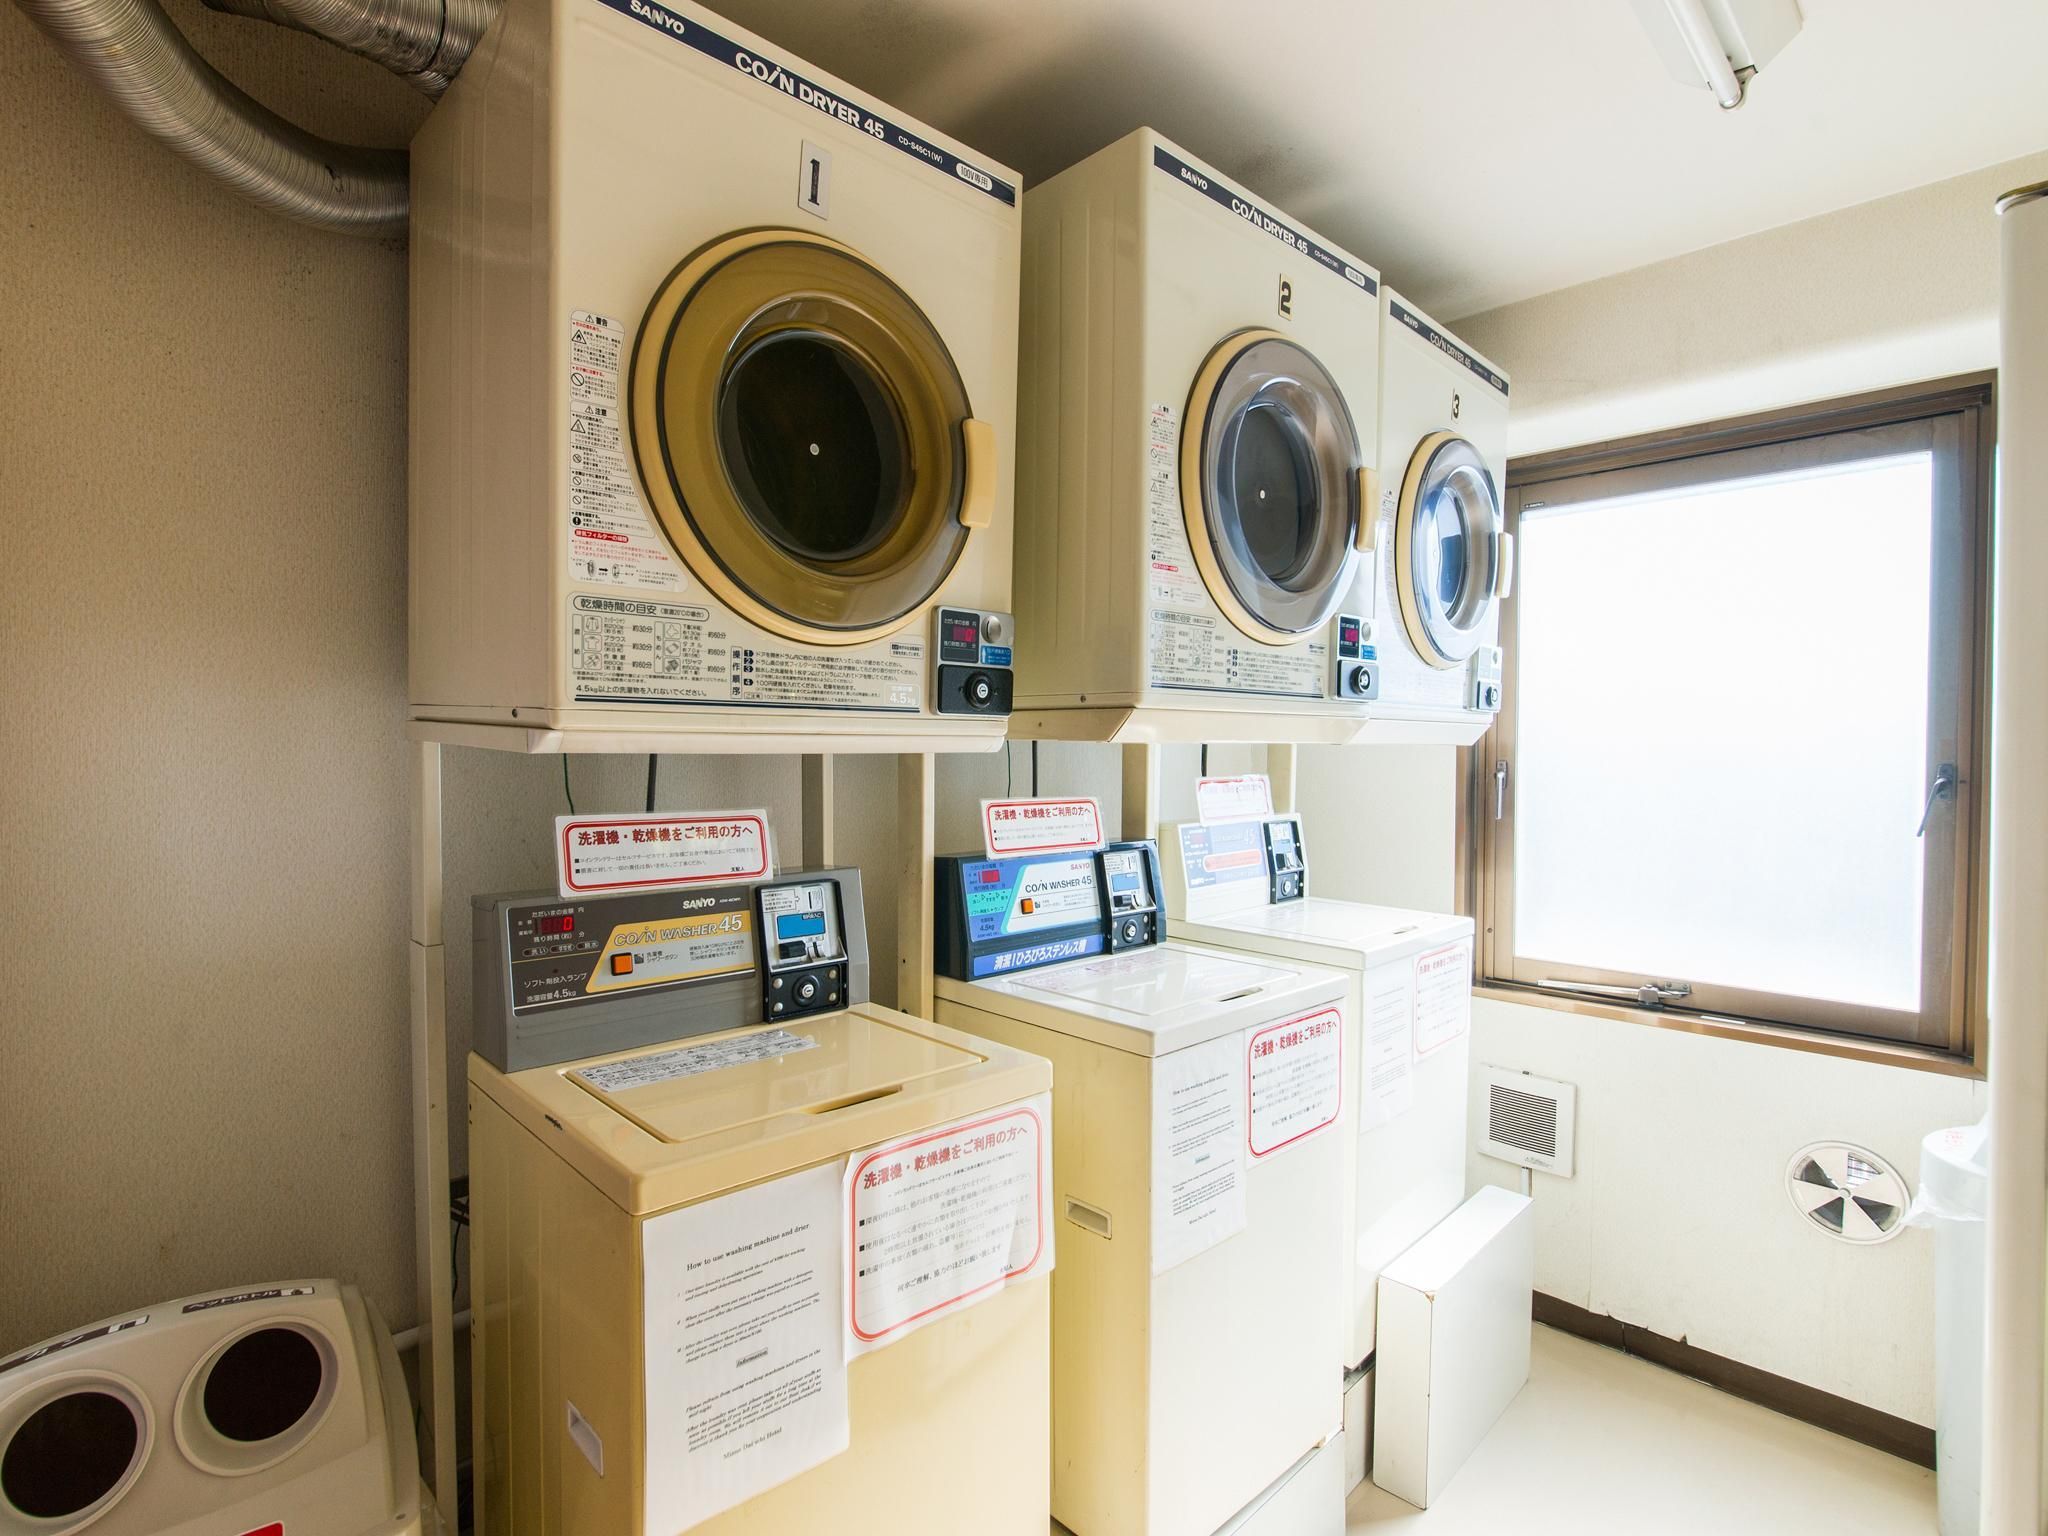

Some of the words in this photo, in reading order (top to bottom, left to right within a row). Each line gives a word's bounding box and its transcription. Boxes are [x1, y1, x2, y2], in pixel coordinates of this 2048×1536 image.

[630, 0, 685, 35] SANYO
[799, 83, 860, 126] DRYER
[864, 117, 885, 139] 45
[808, 159, 820, 206] 1
[1181, 168, 1208, 190] SANYO
[1264, 218, 1295, 247] DRYER
[1297, 239, 1308, 255] 45
[1280, 281, 1292, 315] 2
[1403, 314, 1419, 328] SANYO
[1447, 345, 1464, 363] DRYER
[1453, 394, 1460, 419] 3
[580, 598, 657, 616] 乾燥時間の目安
[732, 650, 741, 696] 操作順序
[994, 806, 1091, 821] 洗濯機・乾燥機をご利用の方へ
[578, 825, 753, 846] 洗濯機・乾燥機をご利用の方へ
[1070, 862, 1090, 871] SANYO
[1049, 879, 1081, 890] WASHER
[1081, 875, 1092, 885] 45
[682, 897, 716, 909] SANYO
[563, 917, 573, 931] 0
[660, 924, 717, 940] WASHER
[718, 914, 743, 932] 45
[1254, 1021, 1337, 1059] 洗濯機・乾燥機をご利用の方へ
[863, 1126, 1027, 1190] 洗濯機・乾燥機をご利用の方へ
[686, 1262, 701, 1271] How
[712, 1254, 724, 1262] use
[725, 1244, 752, 1256] washing
[753, 1234, 780, 1247] machine
[781, 1228, 792, 1237] and
[793, 1223, 809, 1233] drier
